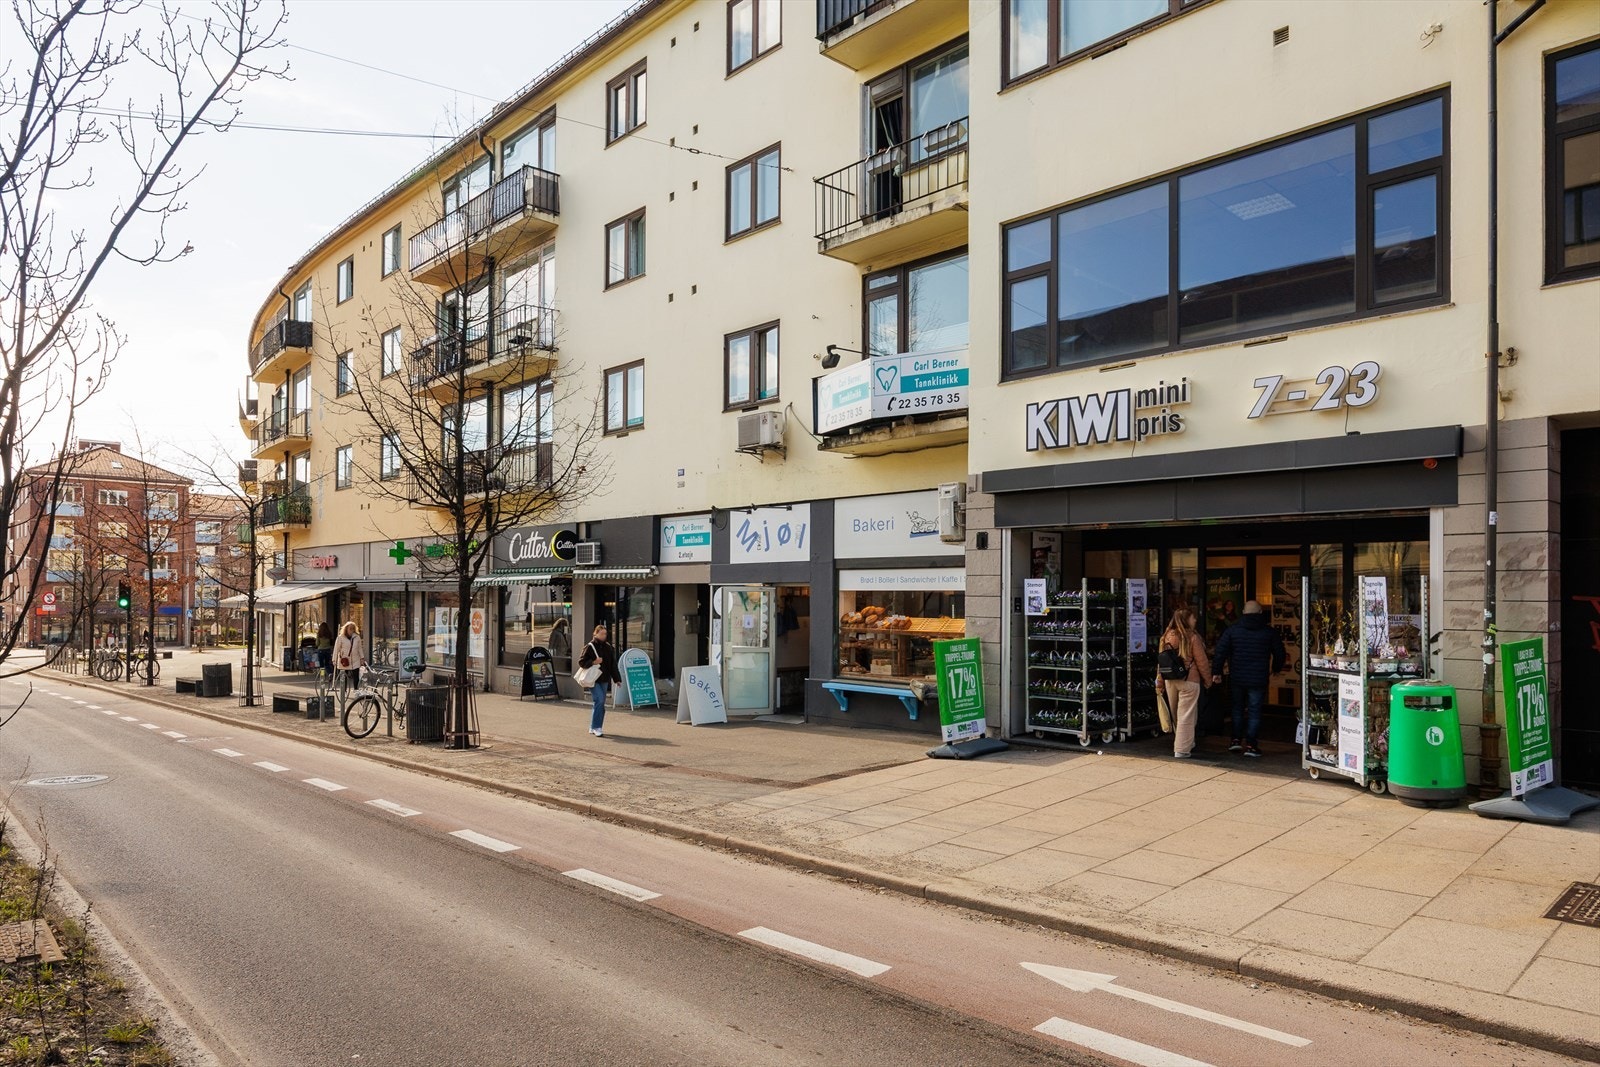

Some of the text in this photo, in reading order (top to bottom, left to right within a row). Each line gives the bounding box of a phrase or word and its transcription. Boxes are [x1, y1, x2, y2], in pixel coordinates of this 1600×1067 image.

[914, 359, 959, 371] Carl Berner
[914, 375, 959, 388] Tannklinikk
[899, 392, 960, 409] 22 35 78 35
[1136, 377, 1188, 408] mini
[831, 406, 863, 425] 22 35 78 35
[1026, 388, 1132, 452] KIWI
[1136, 409, 1182, 441] pris
[853, 516, 894, 533] Bakeri
[556, 540, 576, 550] Cutter
[900, 575, 937, 583] Sandwicher
[941, 575, 958, 583] Kaffe
[948, 666, 976, 699] 17%
[1341, 678, 1361, 687] Magnolia
[689, 674, 722, 709] Bakeri
[1517, 681, 1545, 731] 17%
[1341, 726, 1361, 735] Magnolia
